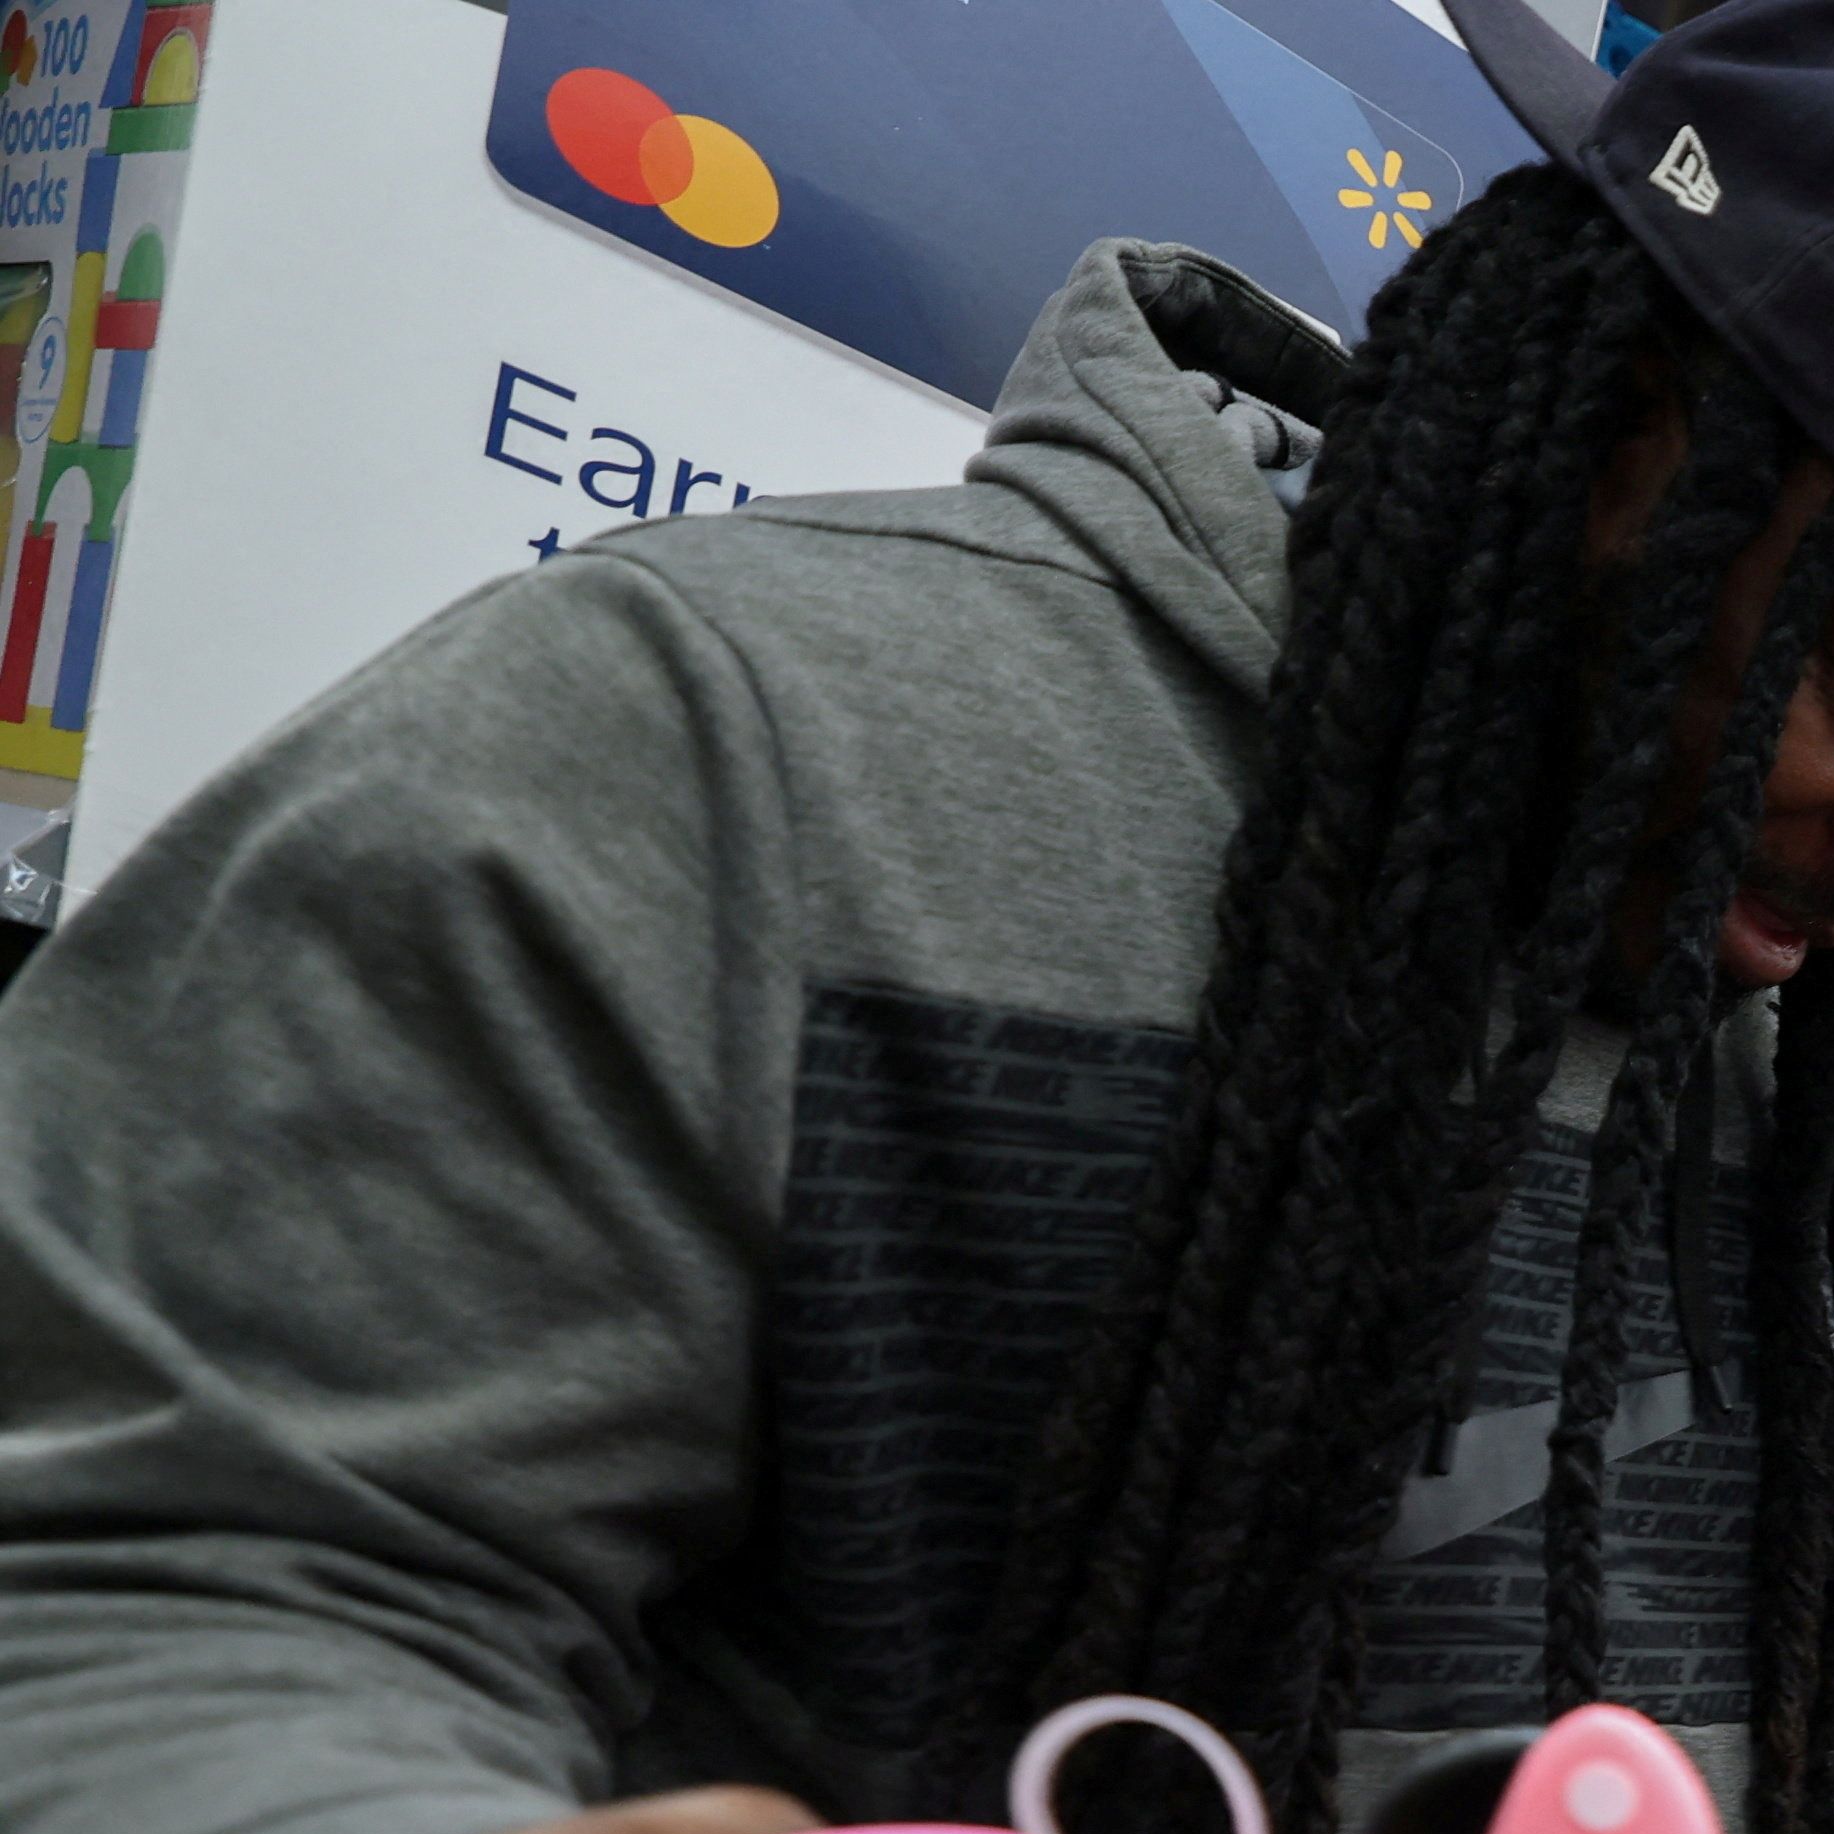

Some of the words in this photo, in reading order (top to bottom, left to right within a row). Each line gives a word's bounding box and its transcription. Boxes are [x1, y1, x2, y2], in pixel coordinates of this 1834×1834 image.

[40, 14, 88, 77] 100
[0, 88, 91, 151] ooden
[0, 162, 68, 229] locks
[39, 335, 56, 390] 9
[527, 526, 578, 566] t
